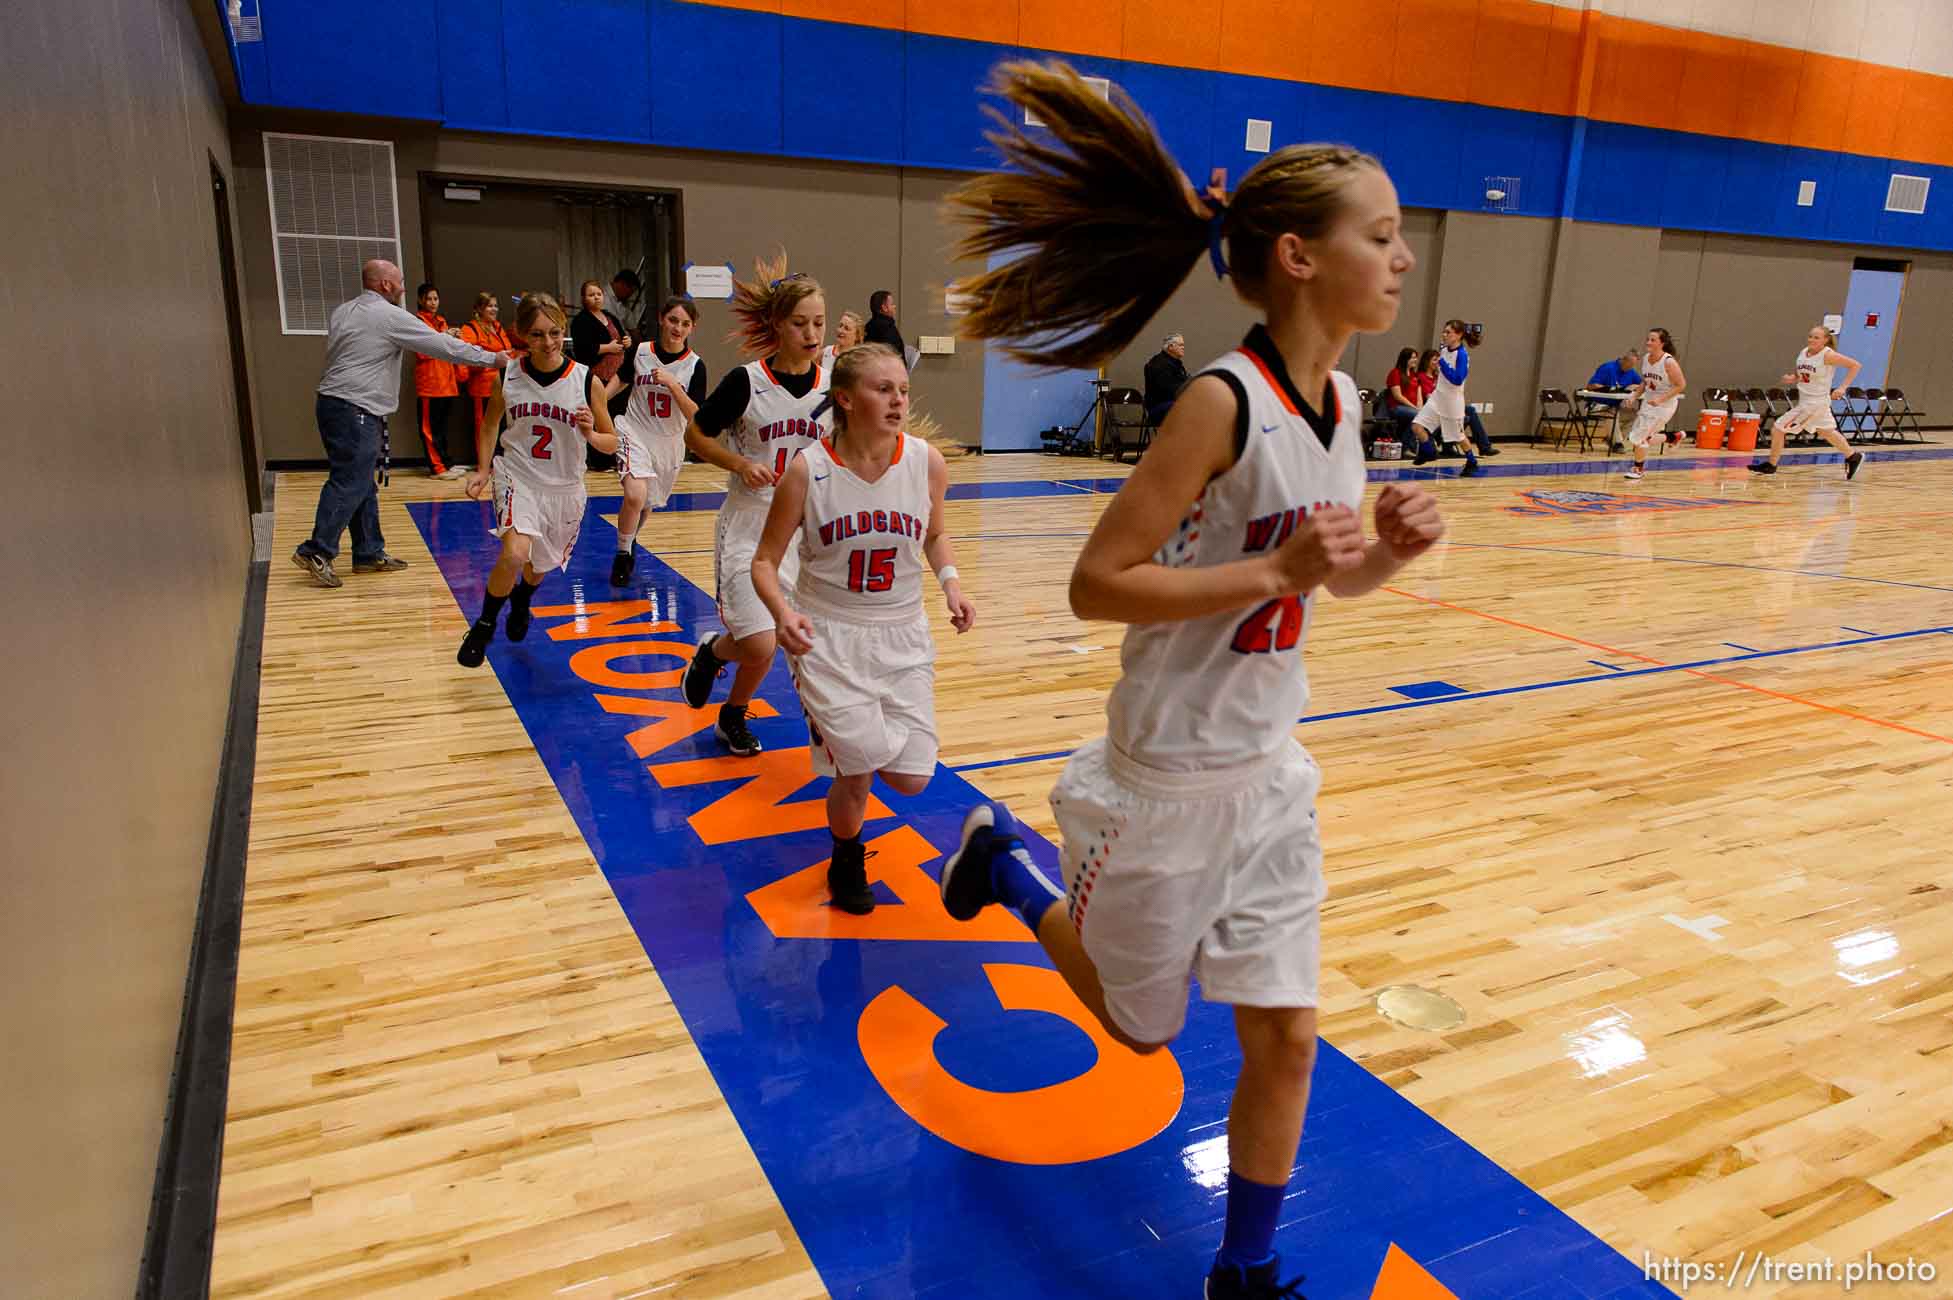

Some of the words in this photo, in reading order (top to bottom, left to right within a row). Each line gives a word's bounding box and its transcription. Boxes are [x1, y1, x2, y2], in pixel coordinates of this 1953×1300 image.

[647, 391, 672, 419] 13
[531, 424, 553, 460] 2
[758, 417, 825, 443] WILDCAT
[772, 447, 804, 487] 1
[848, 546, 898, 593] 15
